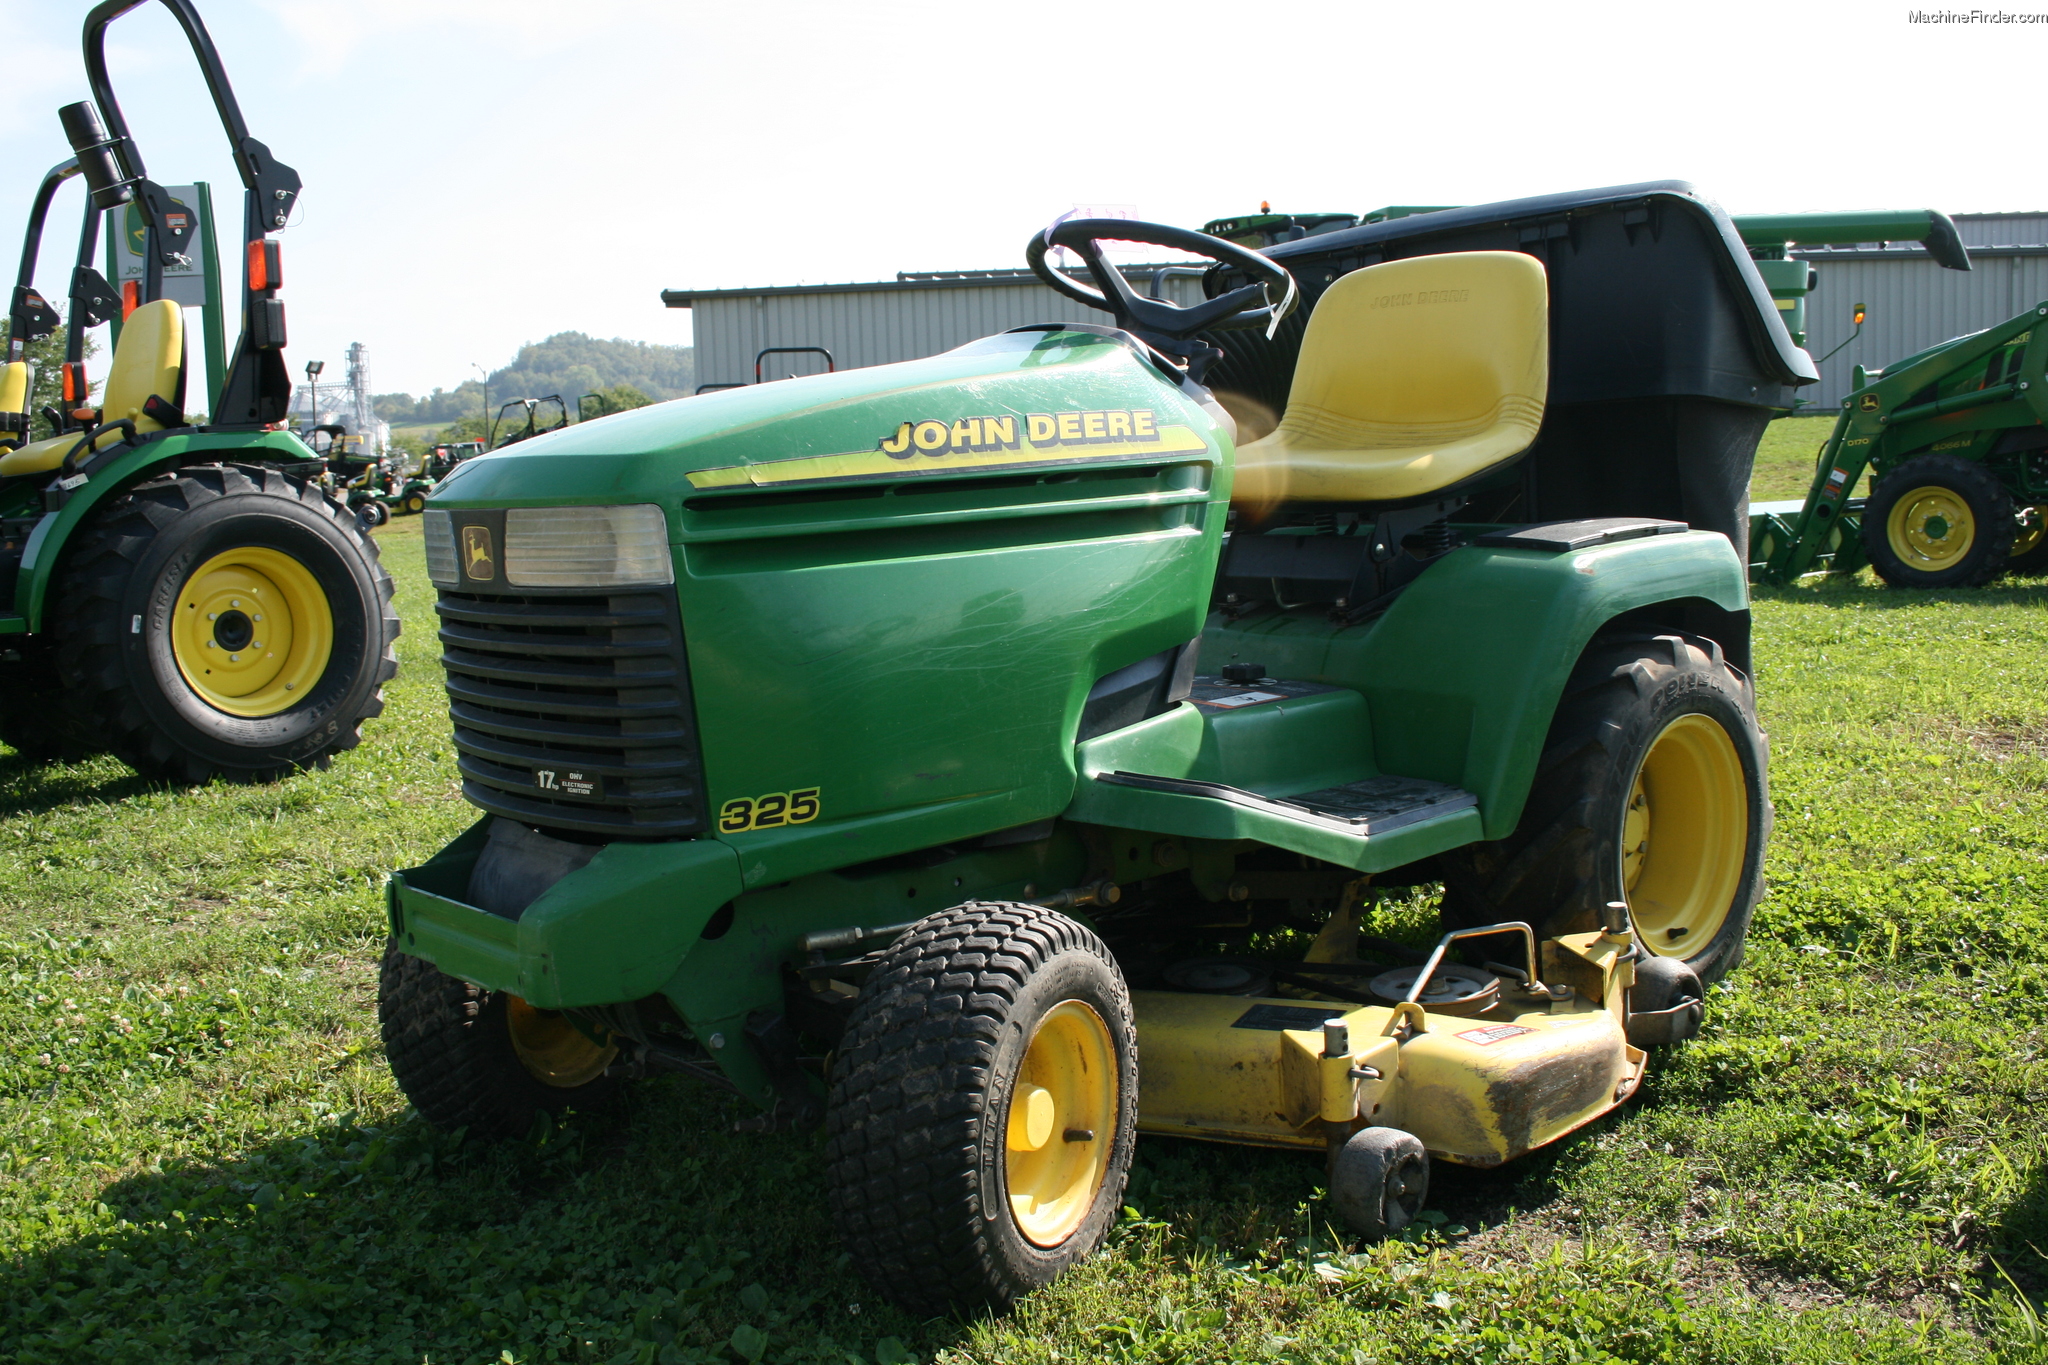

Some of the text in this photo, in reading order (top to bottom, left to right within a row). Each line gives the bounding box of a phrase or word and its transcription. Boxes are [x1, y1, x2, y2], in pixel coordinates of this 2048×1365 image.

[125, 263, 193, 275] JOH EERE
[1370, 289, 1470, 310] JOHN DEERE
[881, 410, 1159, 459] JOHN DEERE
[1847, 437, 1870, 447] D170
[569, 772, 583, 781] OHV
[561, 780, 594, 790] ELECTRONIC
[567, 787, 591, 795] IGNITION
[720, 787, 820, 833] 325
[982, 1067, 1005, 1172] TITAN
